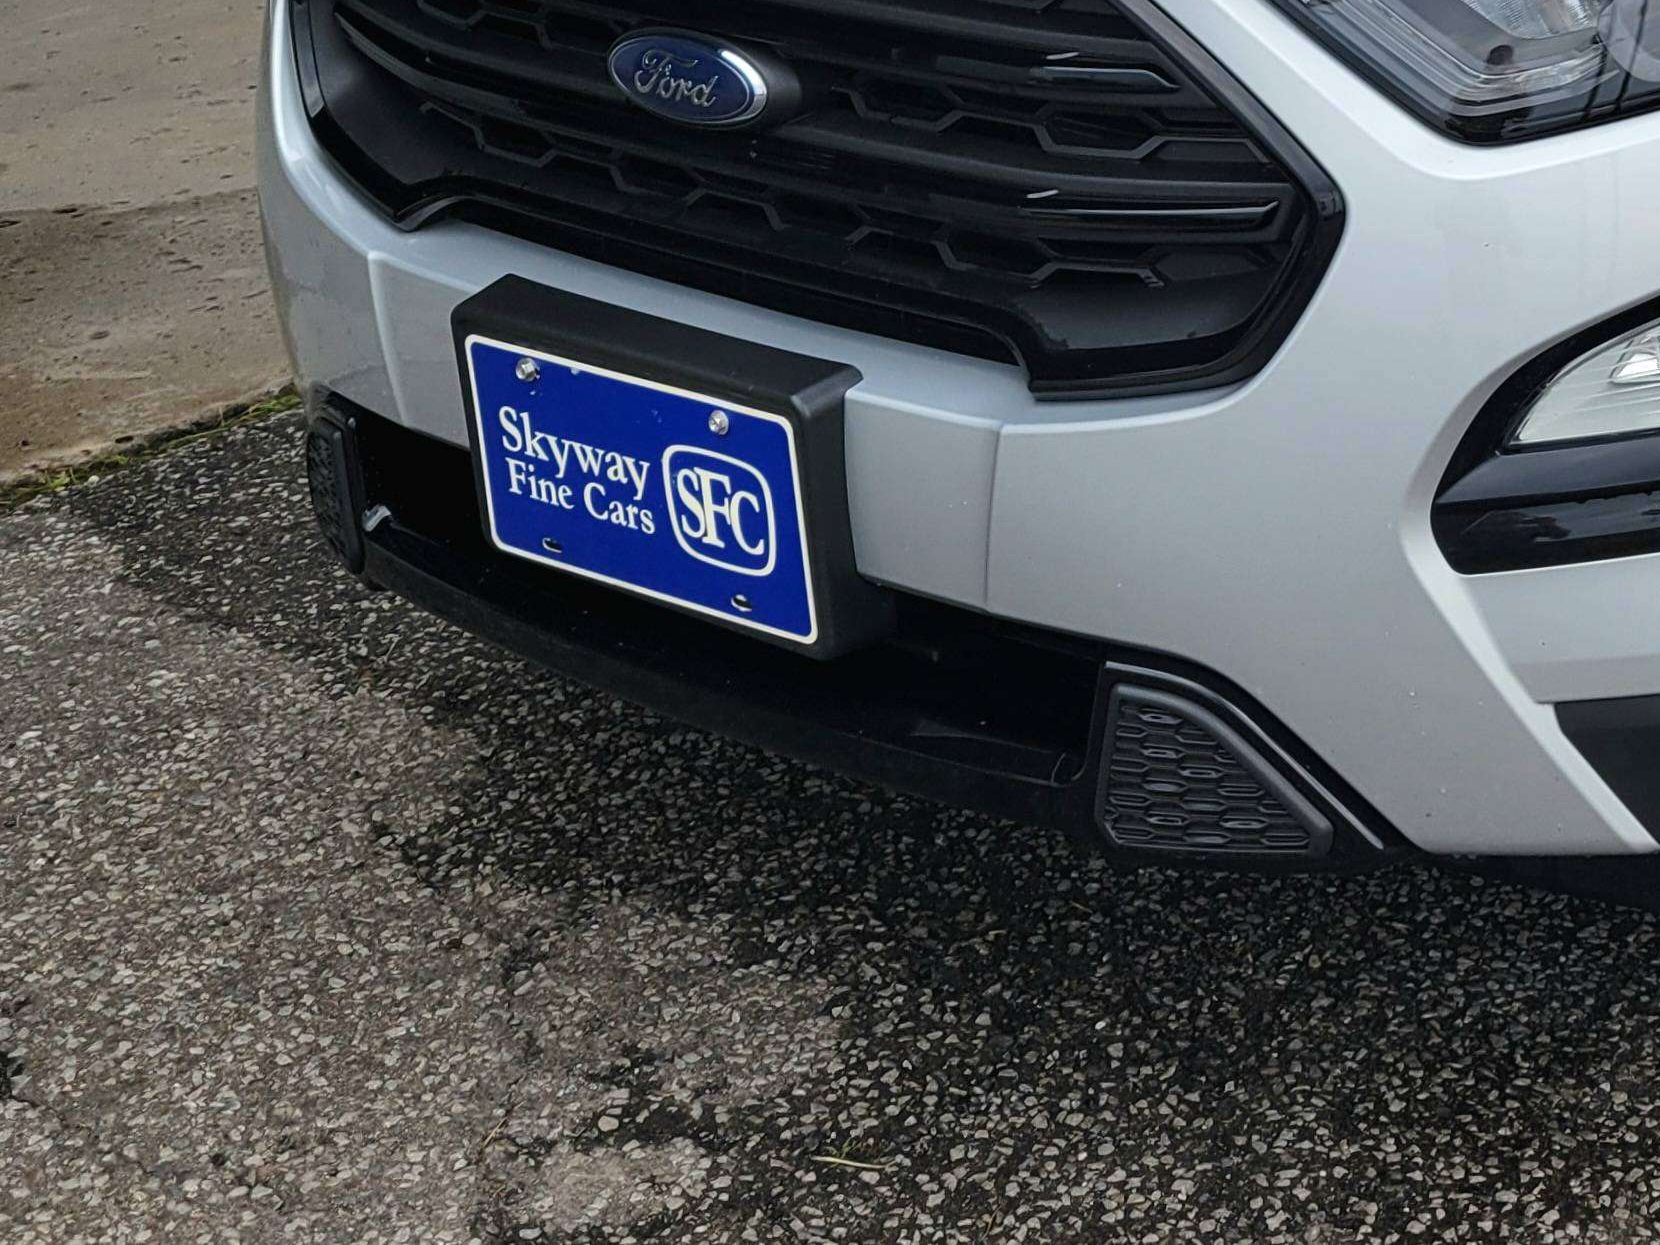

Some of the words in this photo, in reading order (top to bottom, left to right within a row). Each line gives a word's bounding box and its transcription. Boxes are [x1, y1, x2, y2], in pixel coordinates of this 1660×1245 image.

[634, 49, 719, 107] Ford
[499, 406, 650, 500] Skyway
[505, 457, 574, 510] Fine
[584, 483, 656, 535] Cars
[676, 466, 765, 556] SFC
